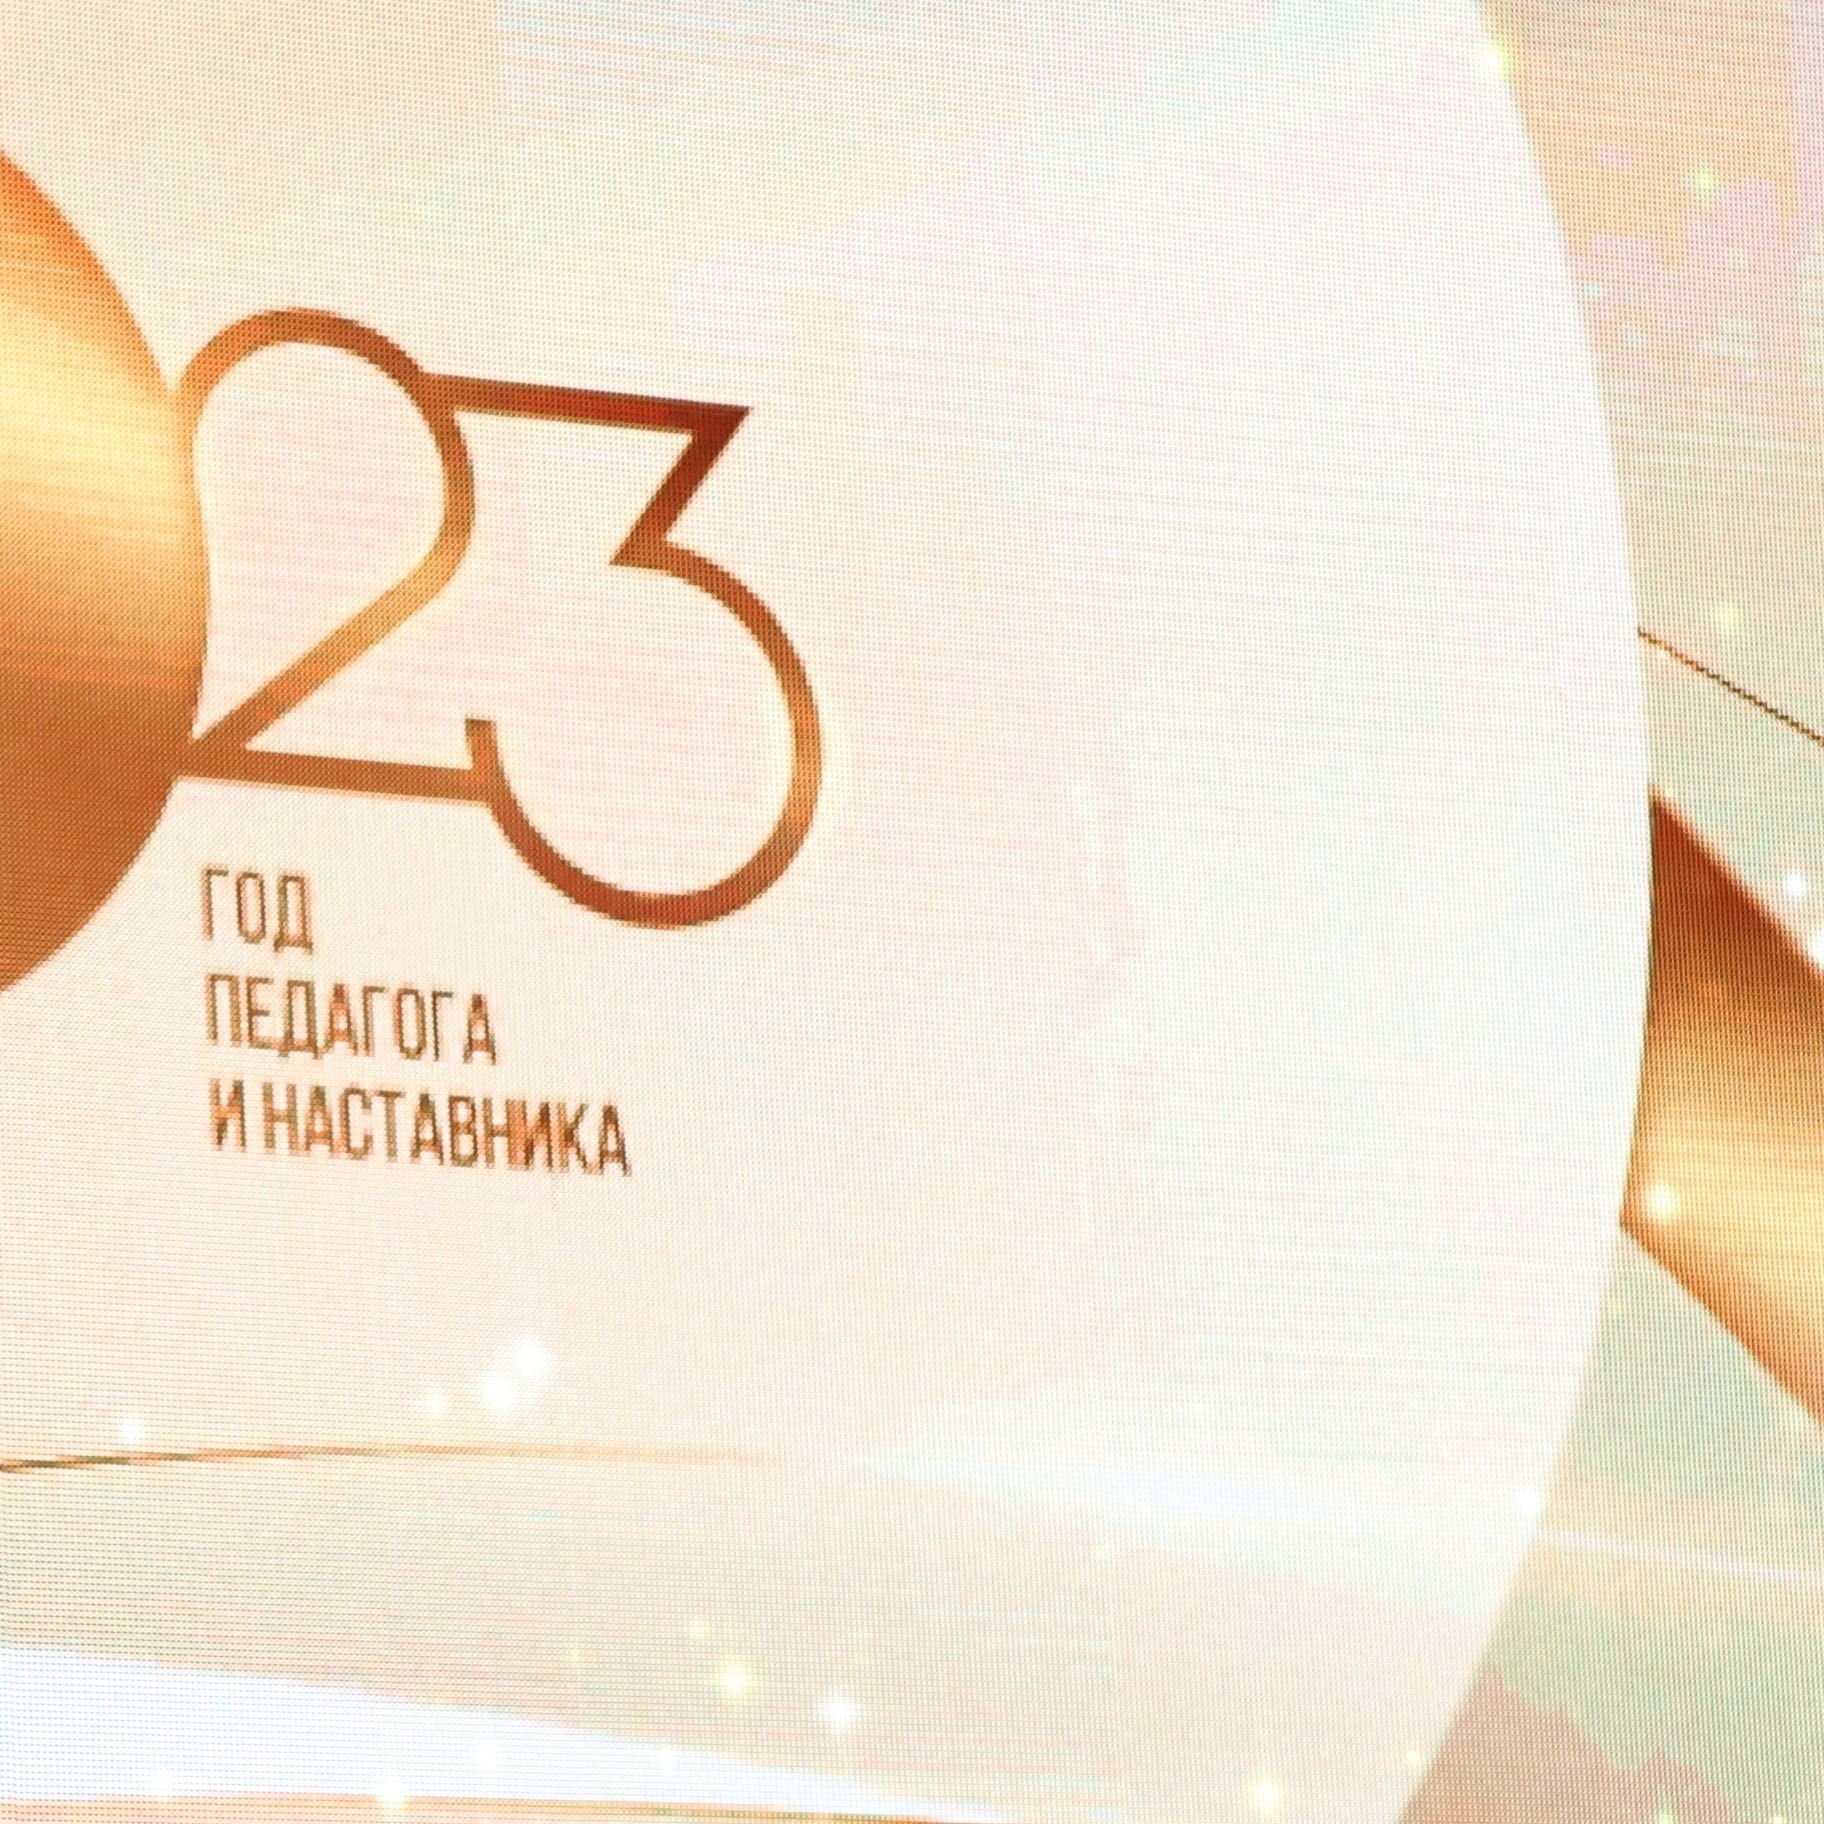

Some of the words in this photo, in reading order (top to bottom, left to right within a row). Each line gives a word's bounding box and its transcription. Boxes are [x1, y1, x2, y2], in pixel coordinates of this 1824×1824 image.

[203, 866, 314, 955] ГОД
[206, 973, 499, 1066] ПЕДАГОГА
[209, 1078, 246, 1153] И
[262, 1081, 632, 1177] НАСТАВНИКА
